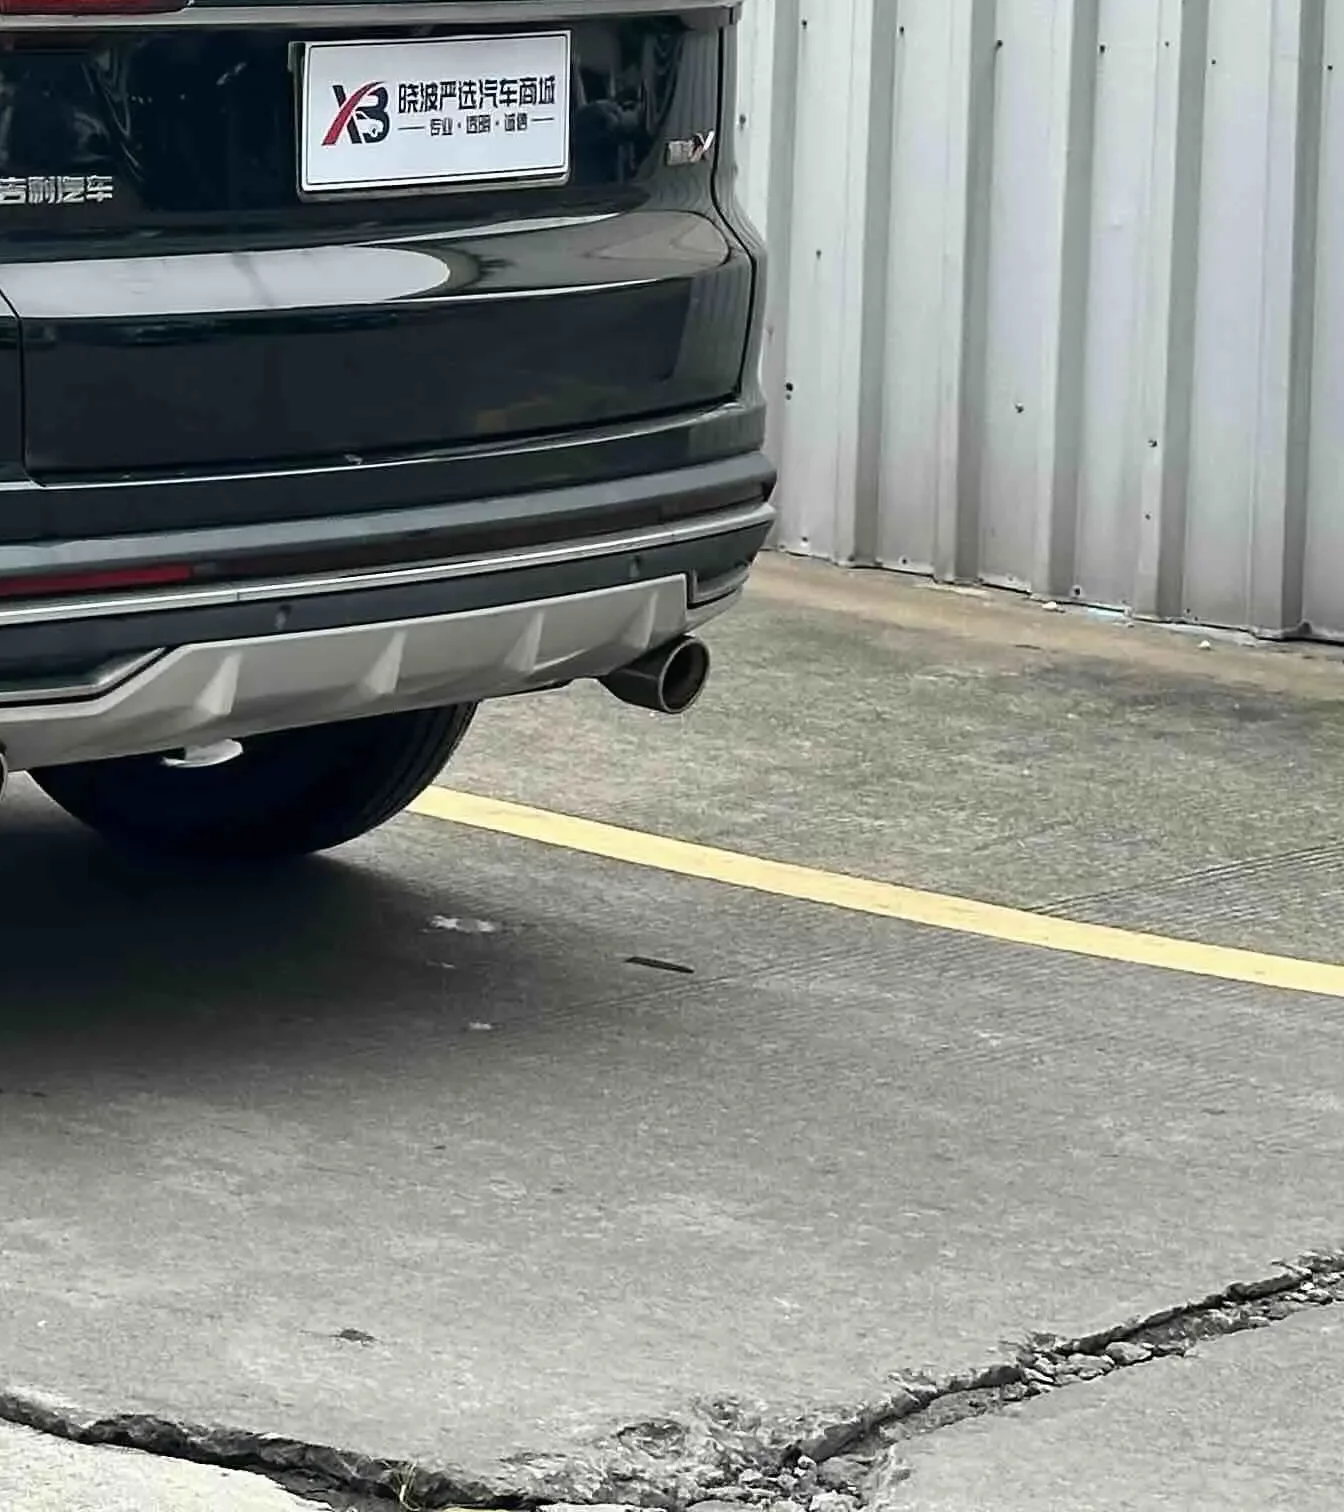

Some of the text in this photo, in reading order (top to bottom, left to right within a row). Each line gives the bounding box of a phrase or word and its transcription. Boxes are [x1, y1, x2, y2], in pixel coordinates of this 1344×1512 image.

[398, 75, 556, 114] 晓波严选汽车商城
